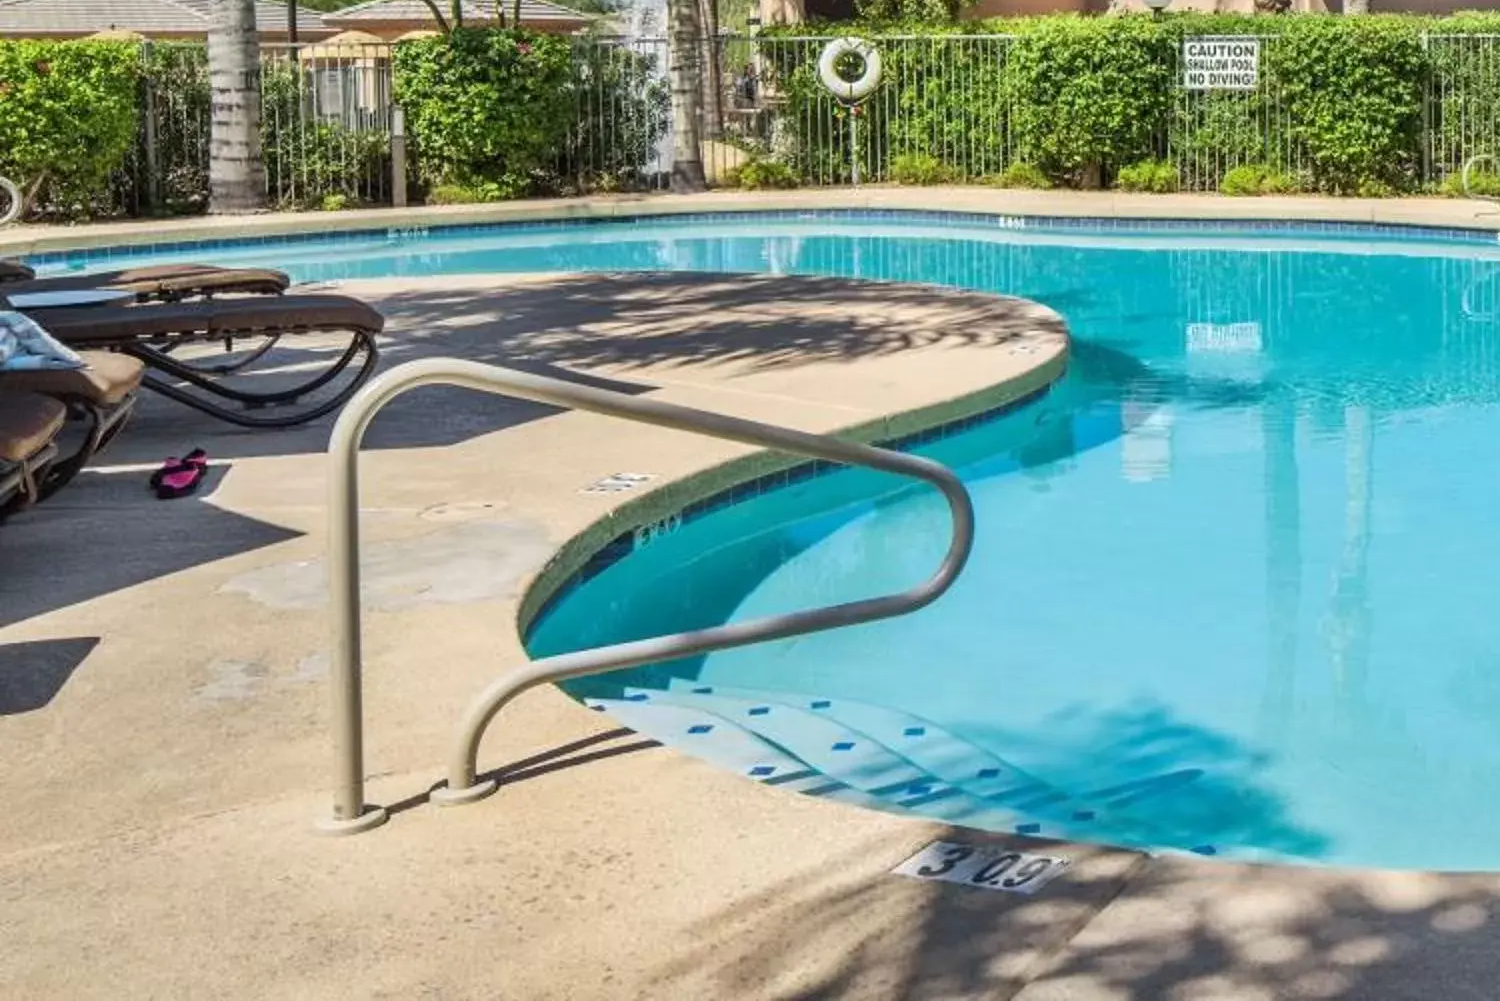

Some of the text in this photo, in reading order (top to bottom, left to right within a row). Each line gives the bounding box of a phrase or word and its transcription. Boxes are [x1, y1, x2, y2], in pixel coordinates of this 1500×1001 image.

[1188, 44, 1255, 57] CAUTION
[1231, 59, 1255, 71] POOL
[1189, 72, 1205, 85] NO
[917, 845, 974, 876] 3
[972, 854, 1051, 888] 0.9
